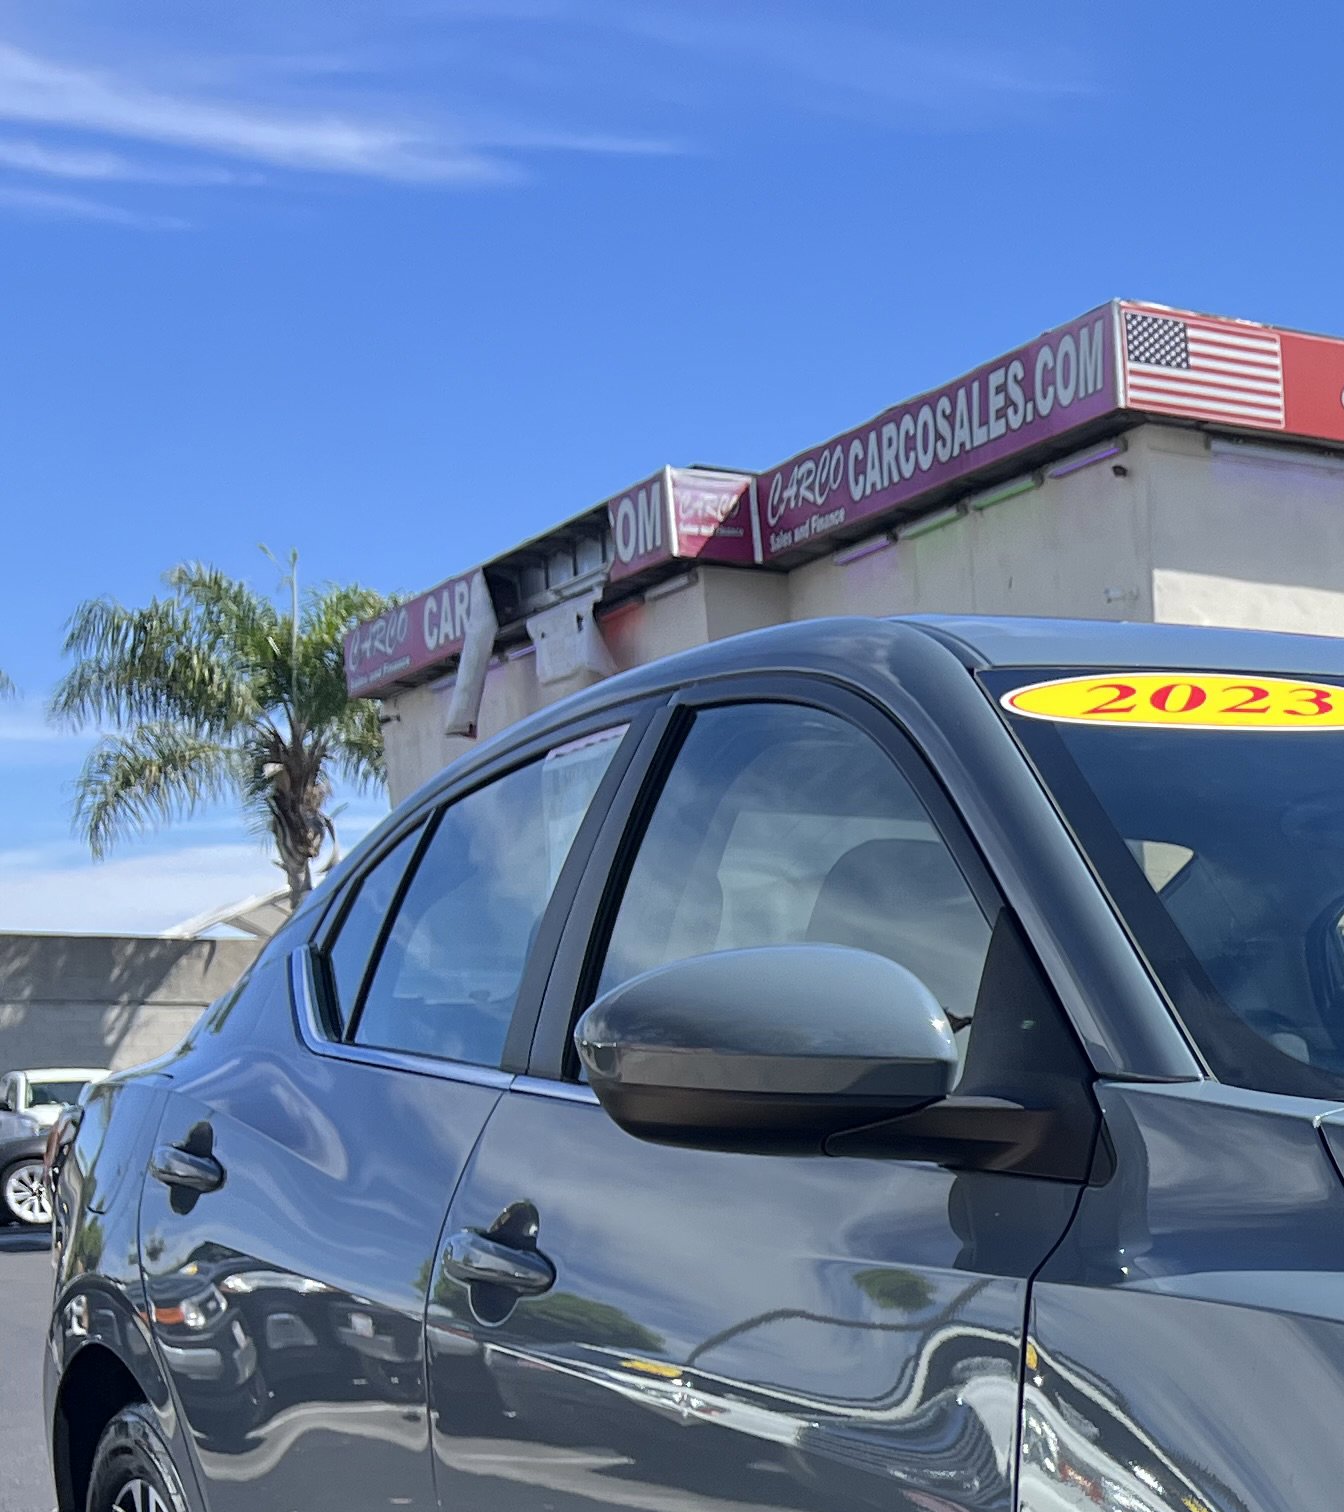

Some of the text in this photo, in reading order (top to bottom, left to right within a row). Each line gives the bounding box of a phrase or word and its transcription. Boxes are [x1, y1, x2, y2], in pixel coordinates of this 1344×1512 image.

[768, 319, 1104, 526] CARCO CARCOSALES.COM
[609, 481, 661, 563] OM
[1082, 683, 1333, 717] 2023
